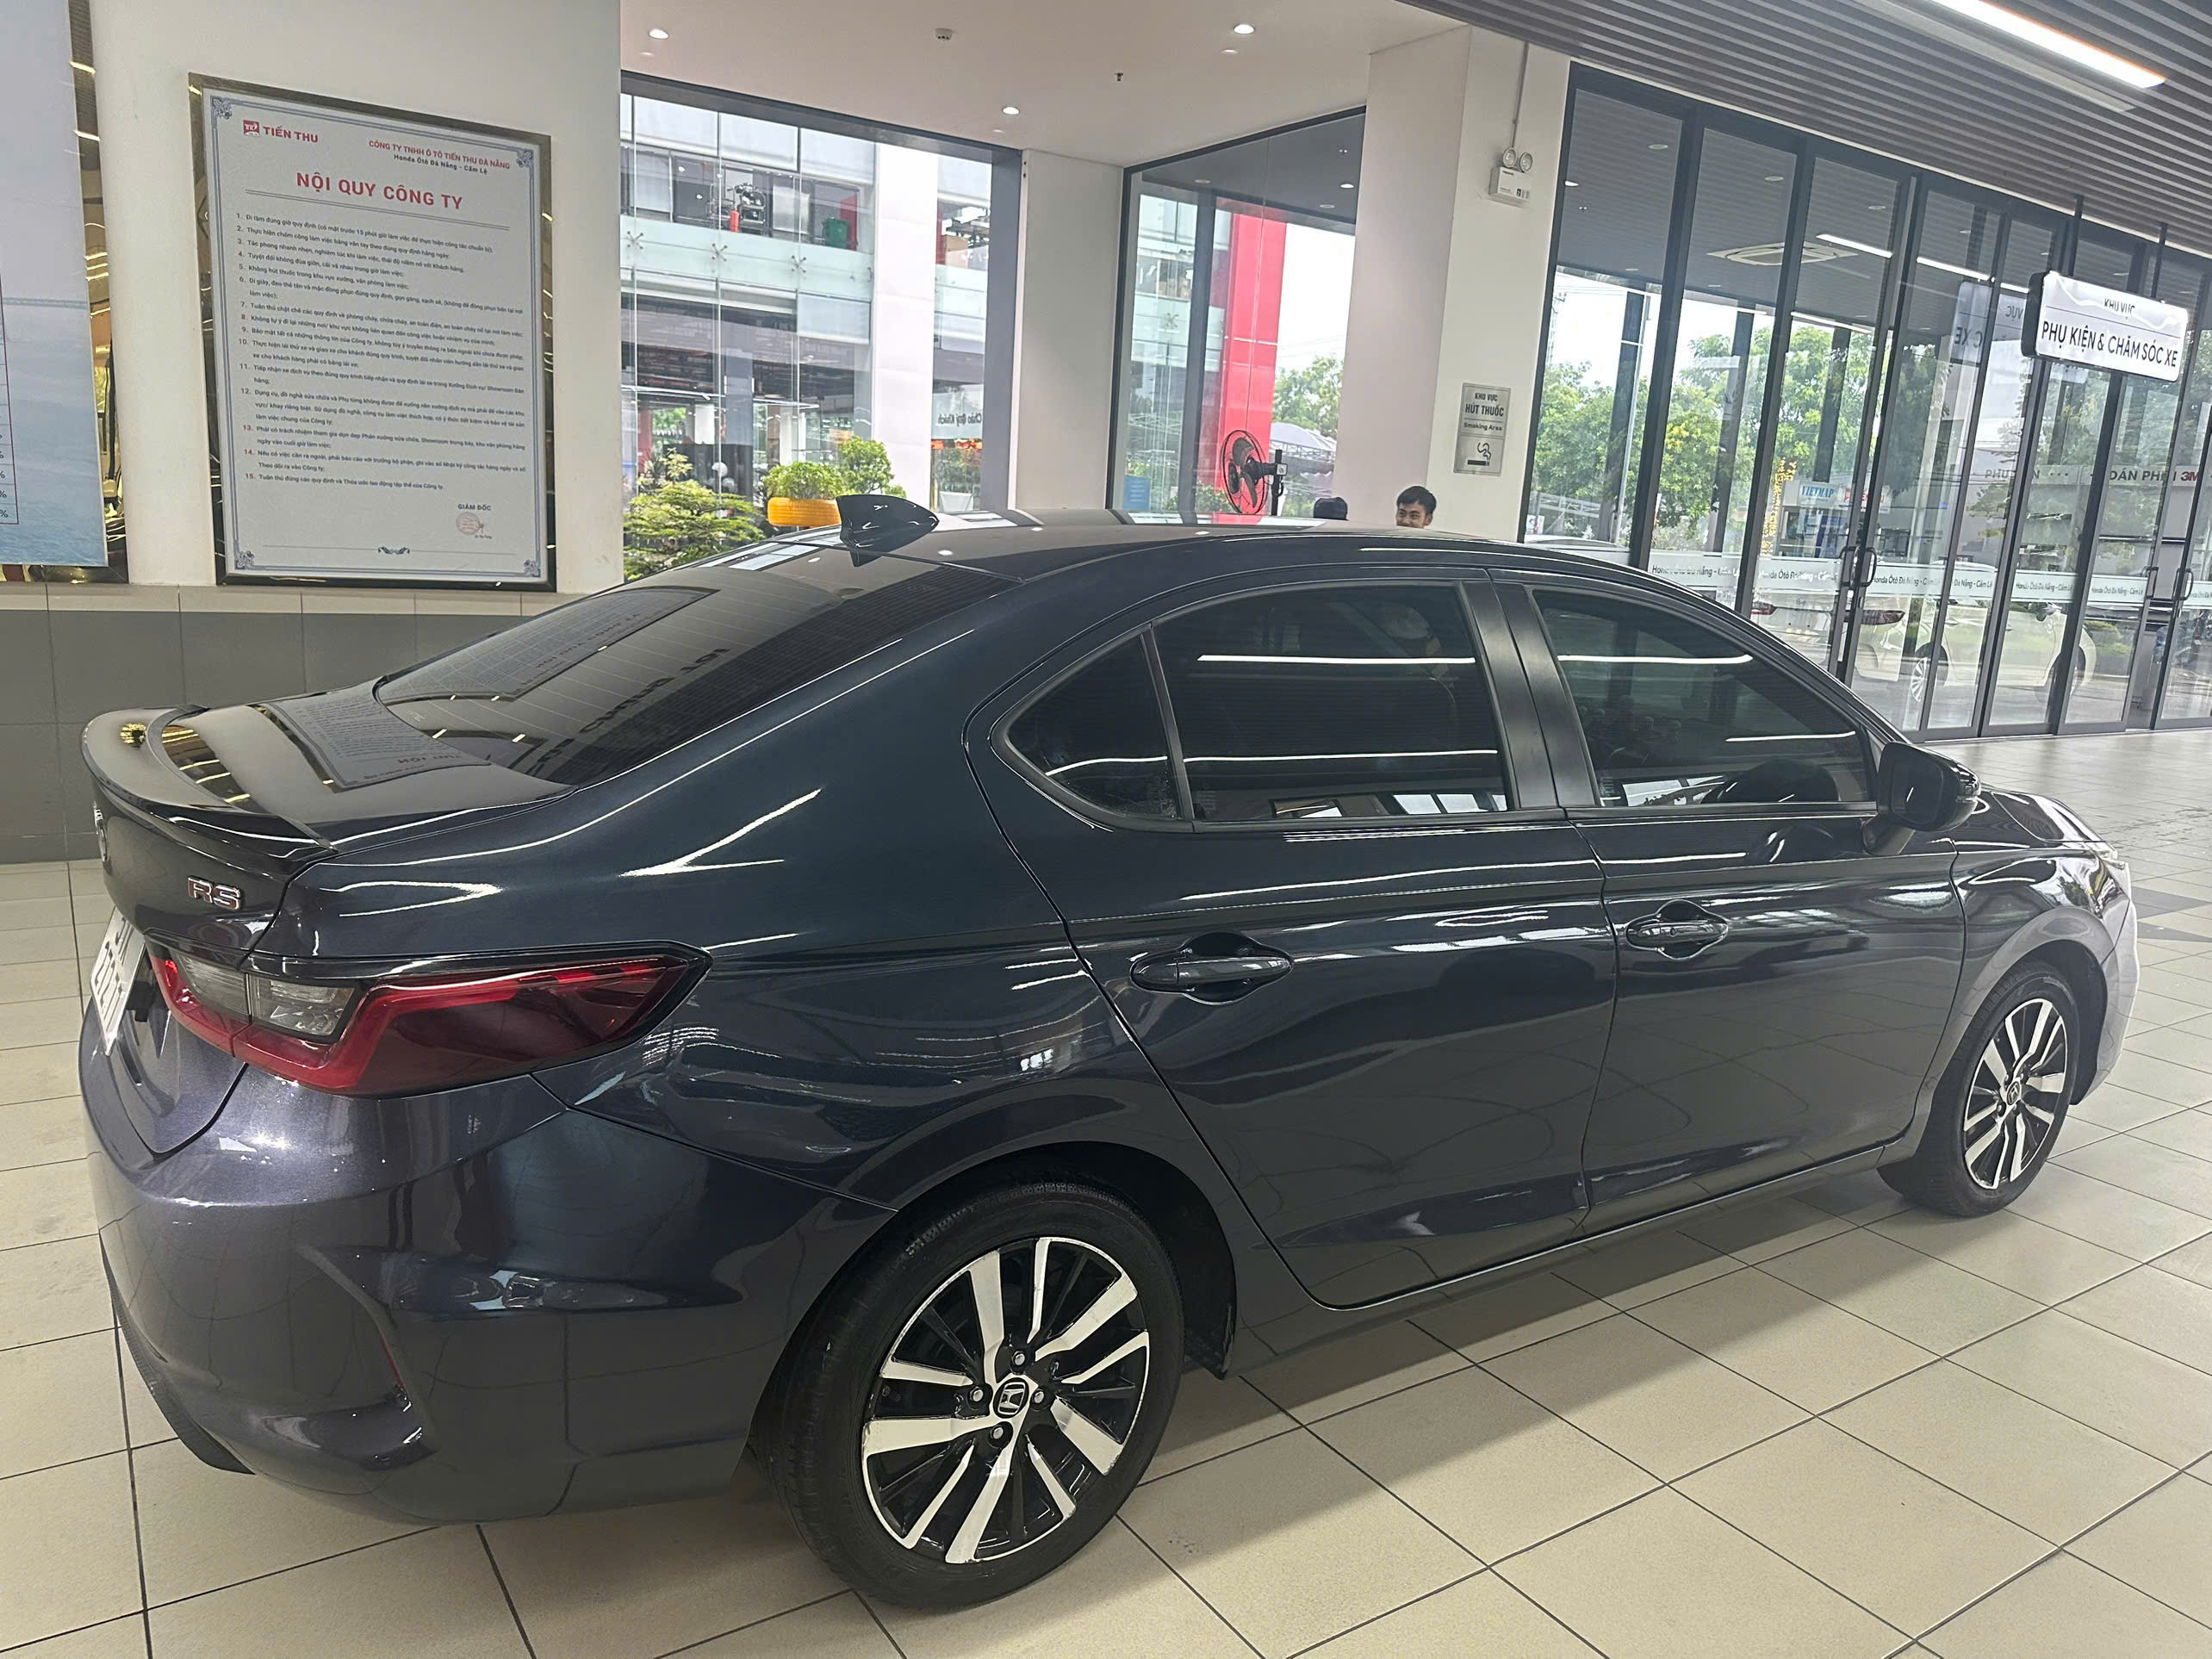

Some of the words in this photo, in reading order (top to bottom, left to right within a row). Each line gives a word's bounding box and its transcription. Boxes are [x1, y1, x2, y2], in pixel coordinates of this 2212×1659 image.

[262, 125, 291, 139] TIẾN
[293, 131, 318, 143] THU
[369, 139, 390, 150] CÔNG
[391, 143, 402, 152] TY
[402, 145, 425, 156] TNHH
[426, 148, 432, 157] Ô
[432, 150, 443, 158] TÔ
[444, 152, 461, 162] TIẾN
[462, 155, 477, 165] THU
[478, 158, 488, 166] ĐÀ
[296, 171, 331, 193] NỘI
[338, 178, 376, 197] QUY
[382, 183, 434, 206] CÔNG
[440, 193, 463, 210] TY
[2041, 321, 2067, 349] PHỤ
[2069, 325, 2097, 352] KIỆN
[2097, 333, 2104, 351] &
[2108, 336, 2141, 358] CHĂM
[2141, 340, 2164, 363] SÓC
[2165, 349, 2178, 367] XE
[1465, 402, 1480, 413] HÚT
[1482, 403, 1505, 417] THUỐC
[1463, 422, 1488, 431] Smoking
[1801, 485, 1835, 498] VIETMAP
[187, 875, 241, 910] RS
